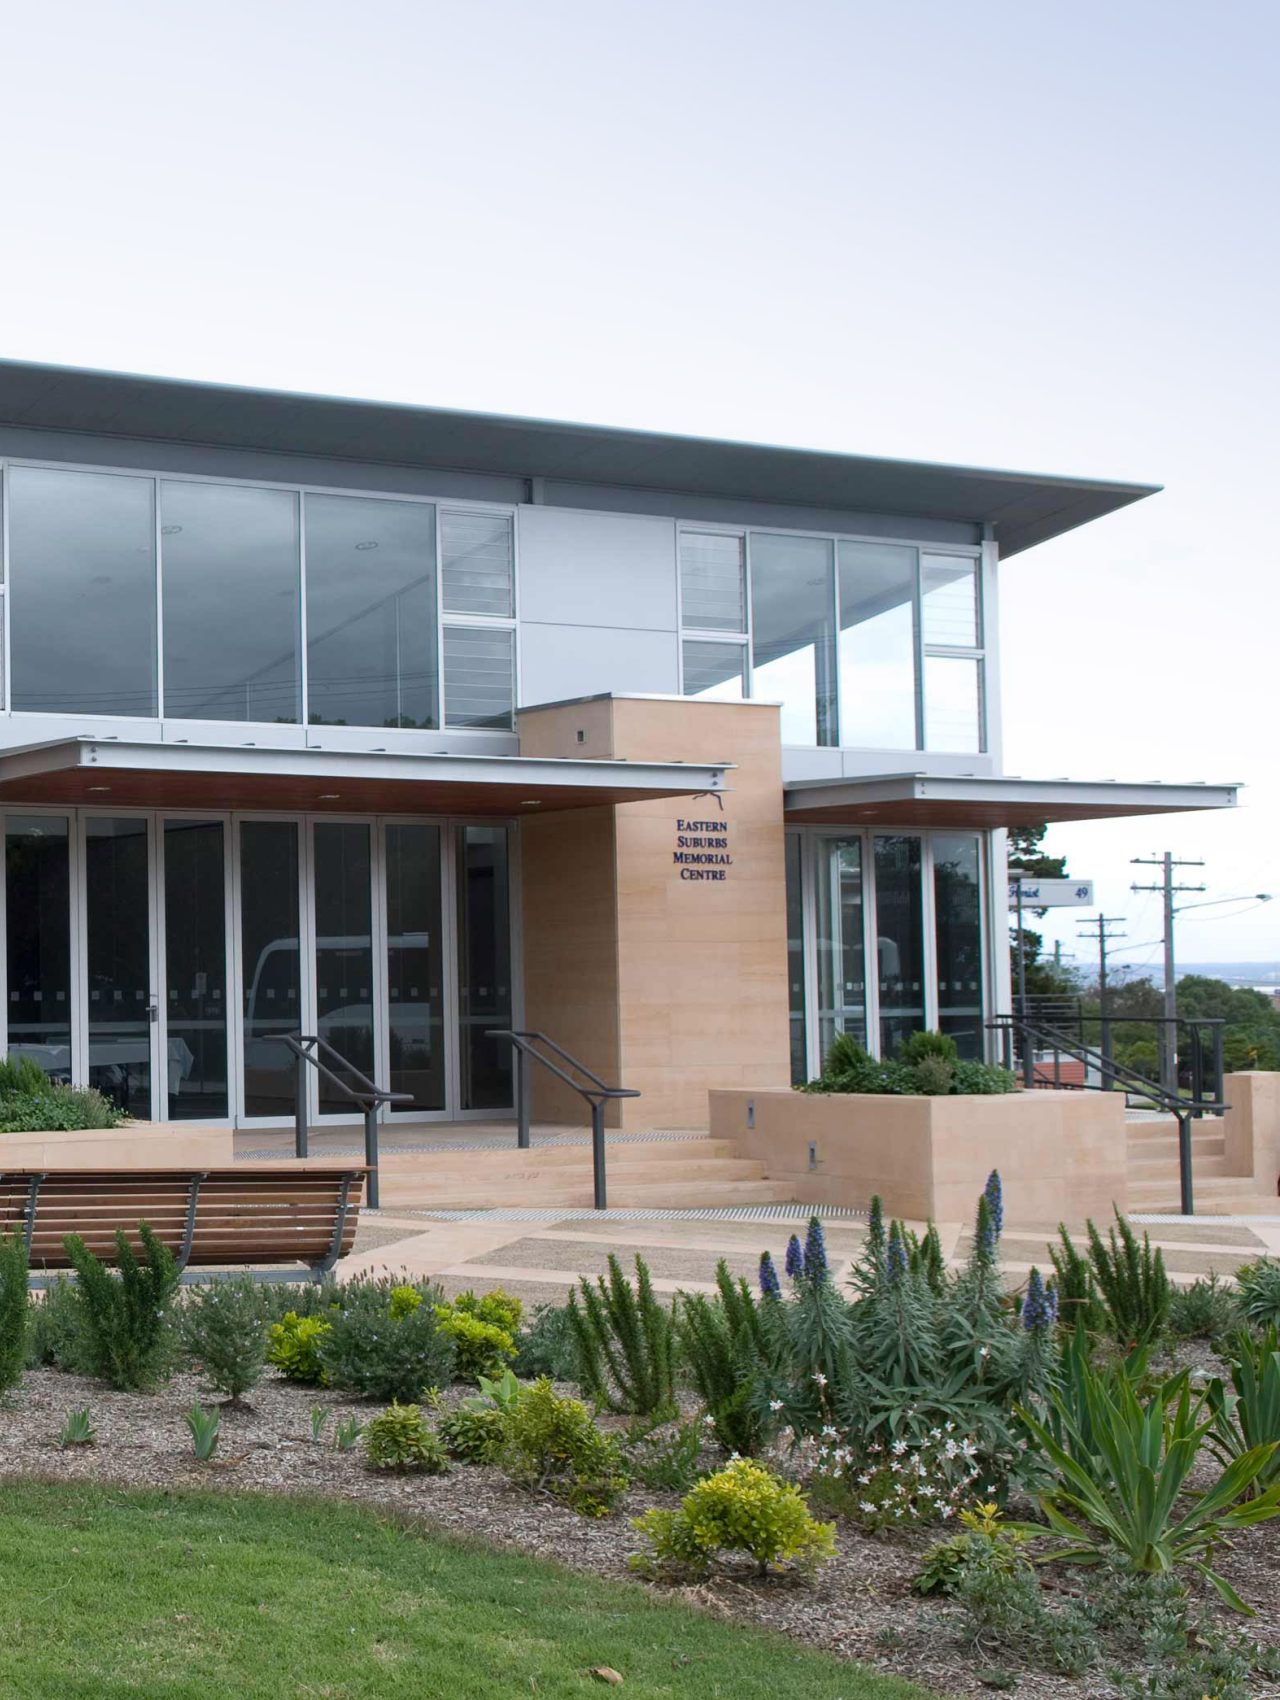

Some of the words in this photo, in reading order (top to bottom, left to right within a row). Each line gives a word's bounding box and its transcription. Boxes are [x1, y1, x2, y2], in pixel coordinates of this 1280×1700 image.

[677, 819, 727, 832] EASTERN
[677, 836, 728, 848] SUBURBS
[673, 852, 733, 865] MEMORIAL
[681, 868, 726, 881] CENTRE
[1075, 887, 1089, 898] 49
